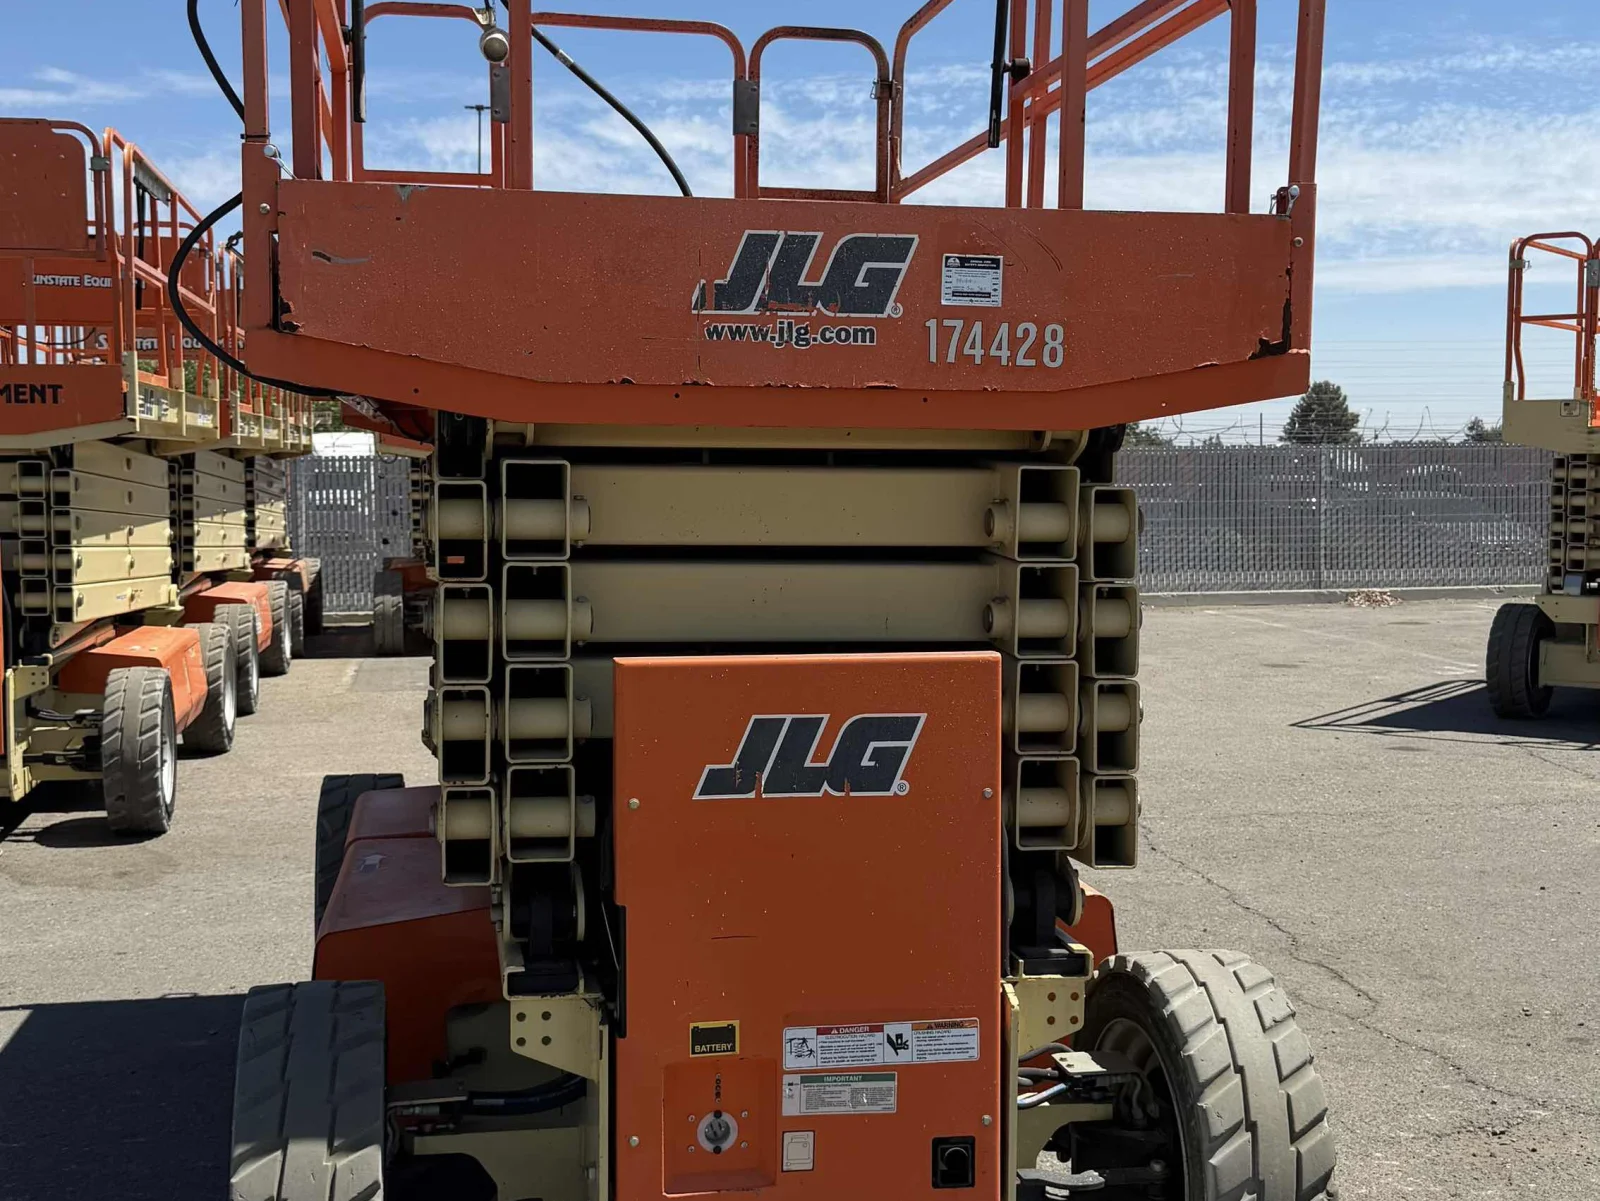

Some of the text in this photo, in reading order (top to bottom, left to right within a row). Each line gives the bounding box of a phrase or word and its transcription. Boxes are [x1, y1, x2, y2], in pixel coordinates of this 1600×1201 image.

[692, 230, 919, 318] JLG
[704, 319, 877, 349] www.jlg.com
[925, 318, 1065, 368] 174428
[692, 713, 927, 799] JLG
[839, 1025, 870, 1034] DANGER
[934, 1020, 964, 1029] WARNING
[694, 1043, 733, 1053] BATTERY
[823, 1075, 862, 1083] IMPORTANT
